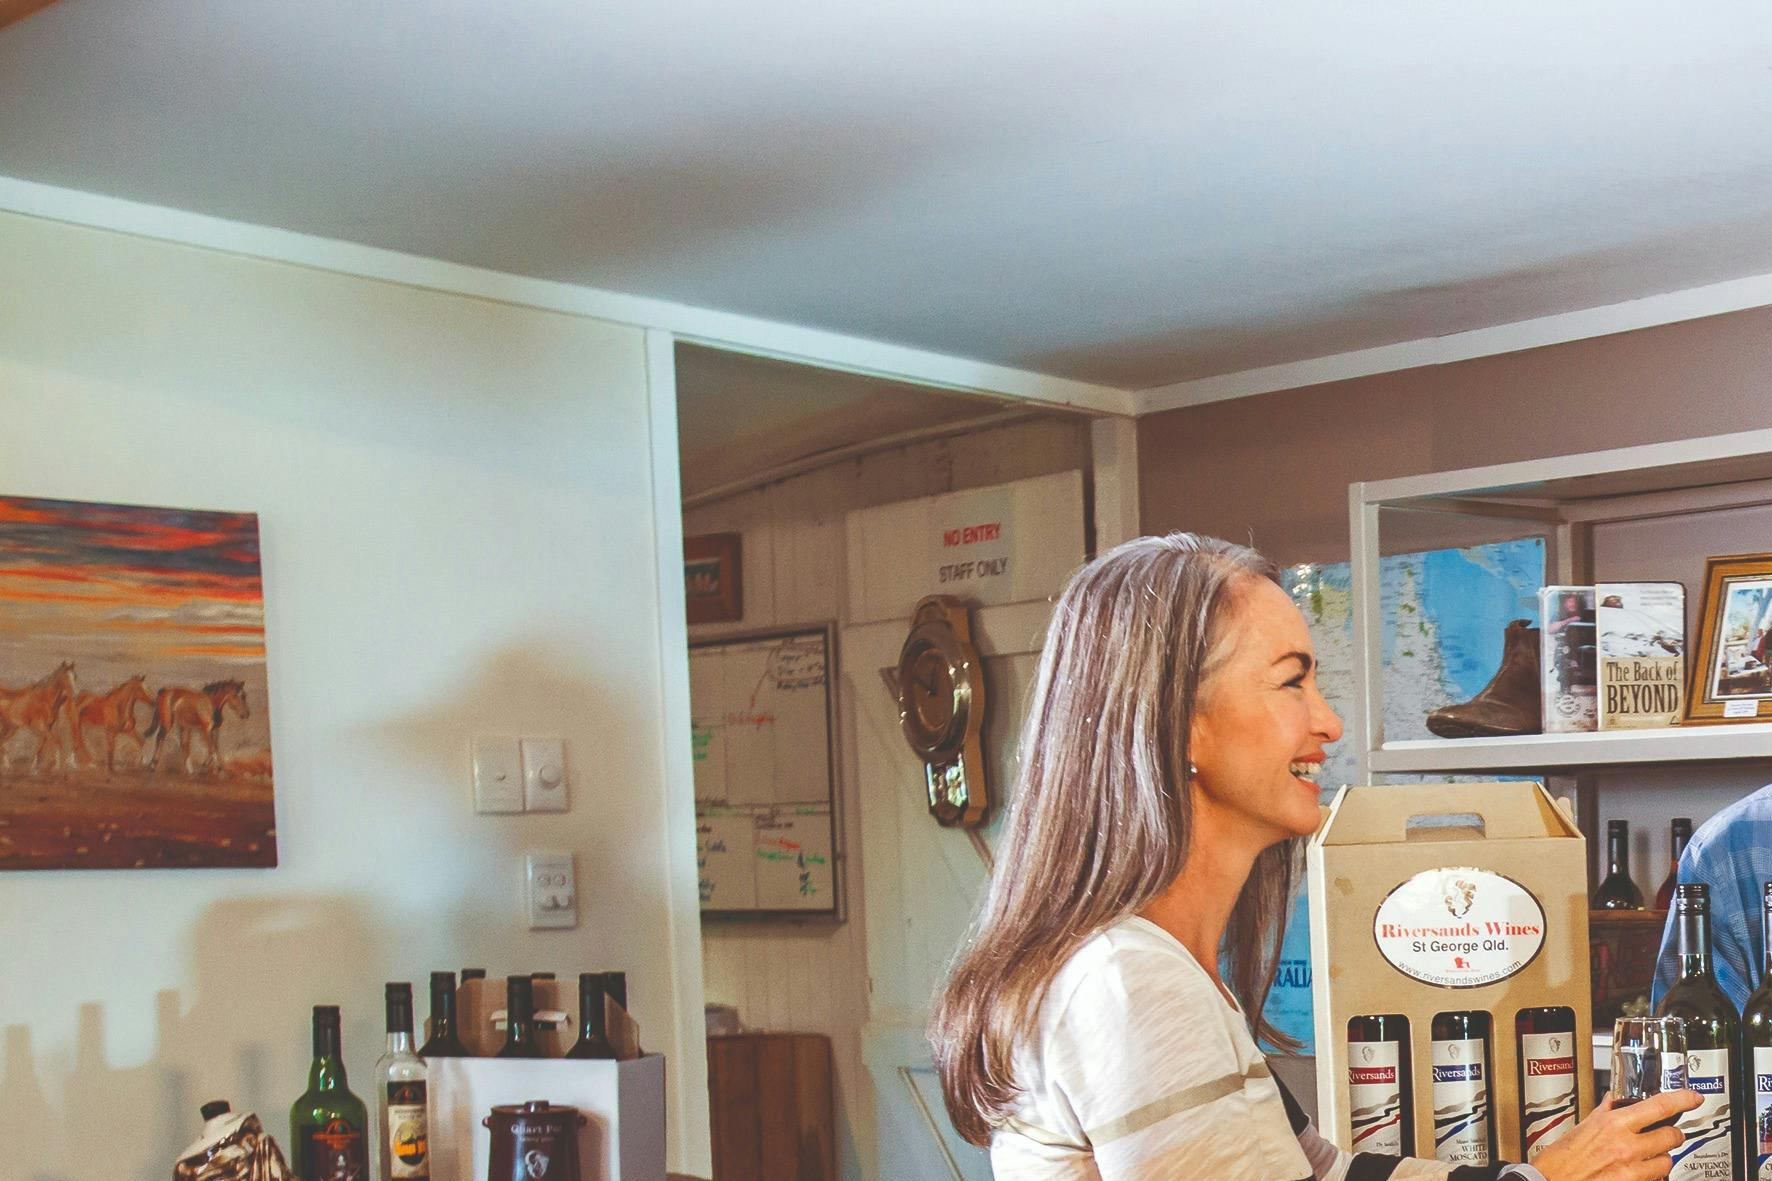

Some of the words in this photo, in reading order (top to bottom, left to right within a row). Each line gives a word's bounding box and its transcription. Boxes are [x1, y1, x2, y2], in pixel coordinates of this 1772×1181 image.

[943, 529, 960, 548] NO
[962, 522, 1002, 545] ENTRY
[939, 561, 975, 583] STAFF
[976, 556, 1009, 578] ONLY
[1606, 661, 1630, 682] The
[1633, 660, 1662, 682] Back
[1665, 660, 1680, 682] of
[1606, 684, 1679, 714] BEYOND
[1381, 922, 1480, 939] Riversands
[1484, 922, 1540, 937] Wines
[1412, 940, 1426, 953] St
[1430, 941, 1479, 954] George
[1483, 939, 1509, 952] Qld.
[1398, 959, 1522, 985] www.riversandswines.com
[1432, 1065, 1481, 1082] Riversands
[1529, 1057, 1575, 1075] Riversand
[1347, 1069, 1395, 1084] Riversands
[1449, 1152, 1488, 1162] MOSCATO
[1461, 1144, 1487, 1153] WHITE
[1684, 1160, 1730, 1171] SAUVIGNON
[1704, 1169, 1730, 1178] BLANC
